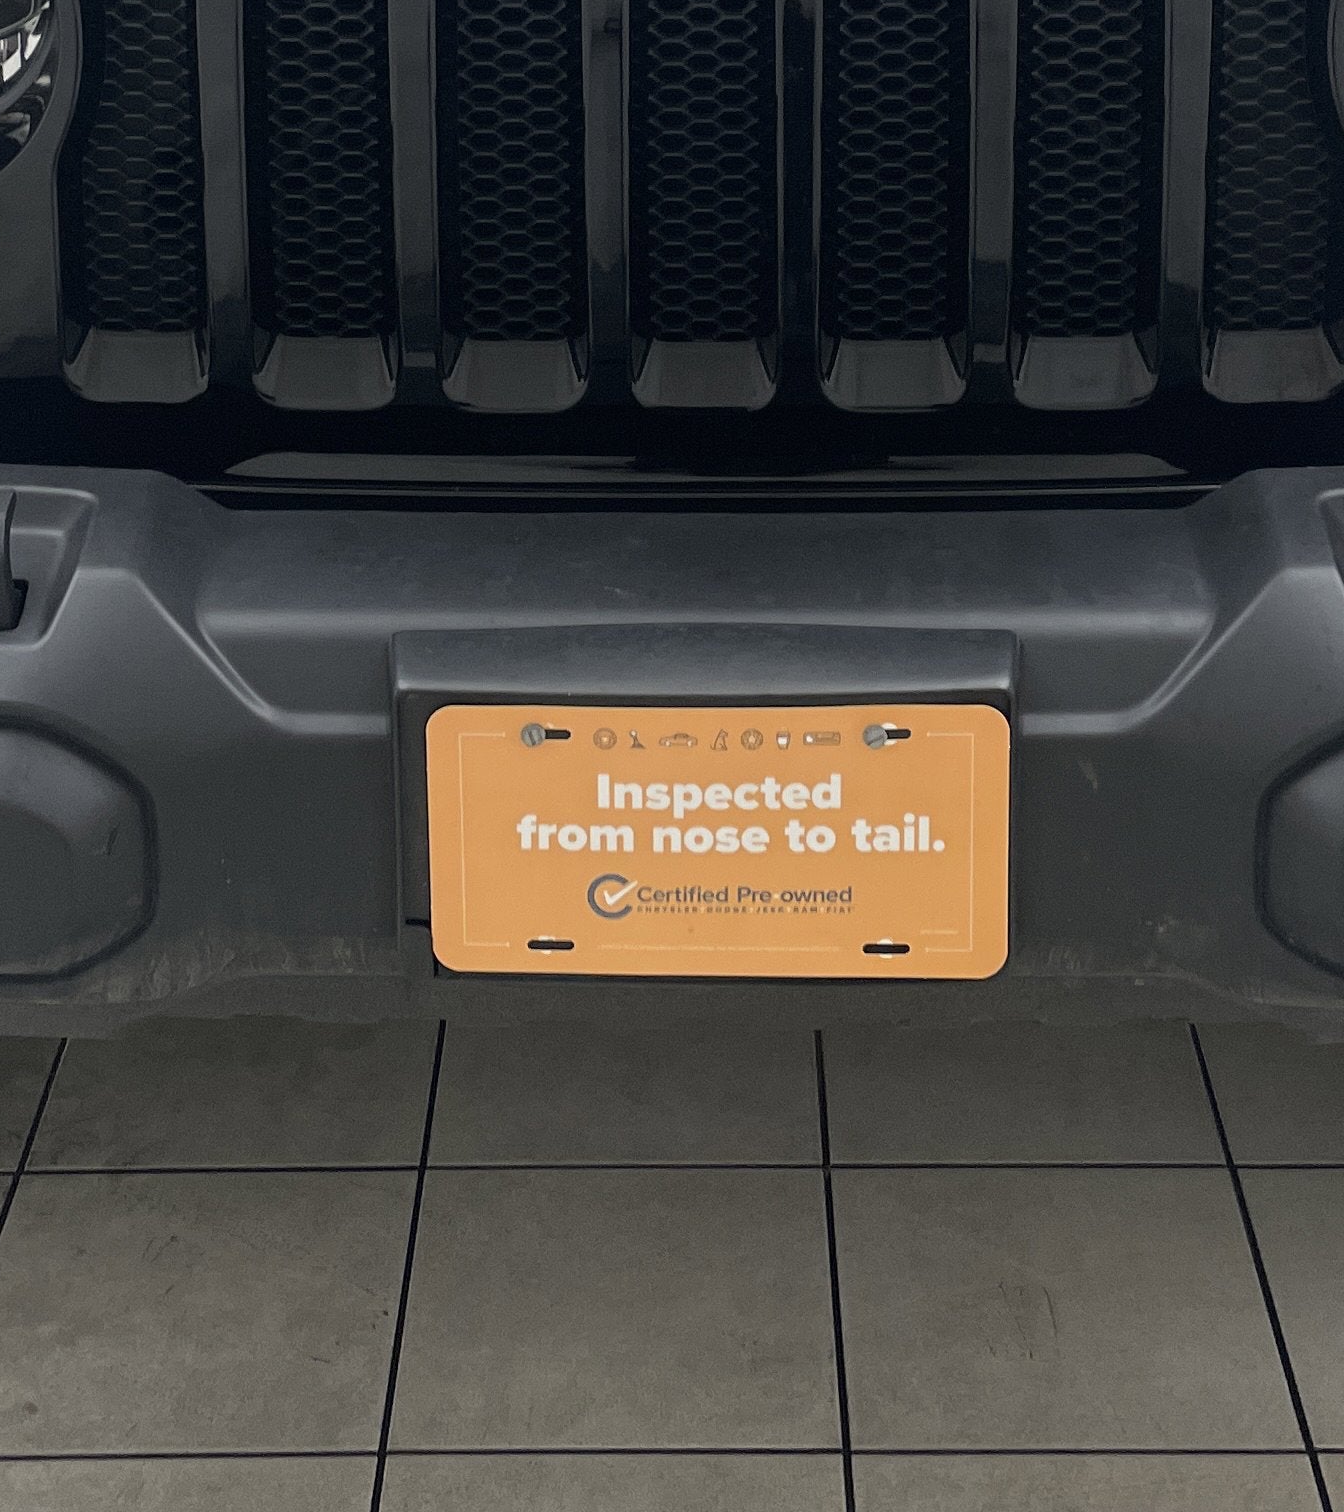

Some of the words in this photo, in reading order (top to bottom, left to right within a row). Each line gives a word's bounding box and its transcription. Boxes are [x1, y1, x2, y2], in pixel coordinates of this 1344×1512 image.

[597, 773, 842, 819] Inspected
[517, 814, 634, 852] from
[652, 824, 770, 853] nose
[785, 819, 837, 853] to
[852, 814, 946, 853] tail.
[637, 885, 729, 903] Certified
